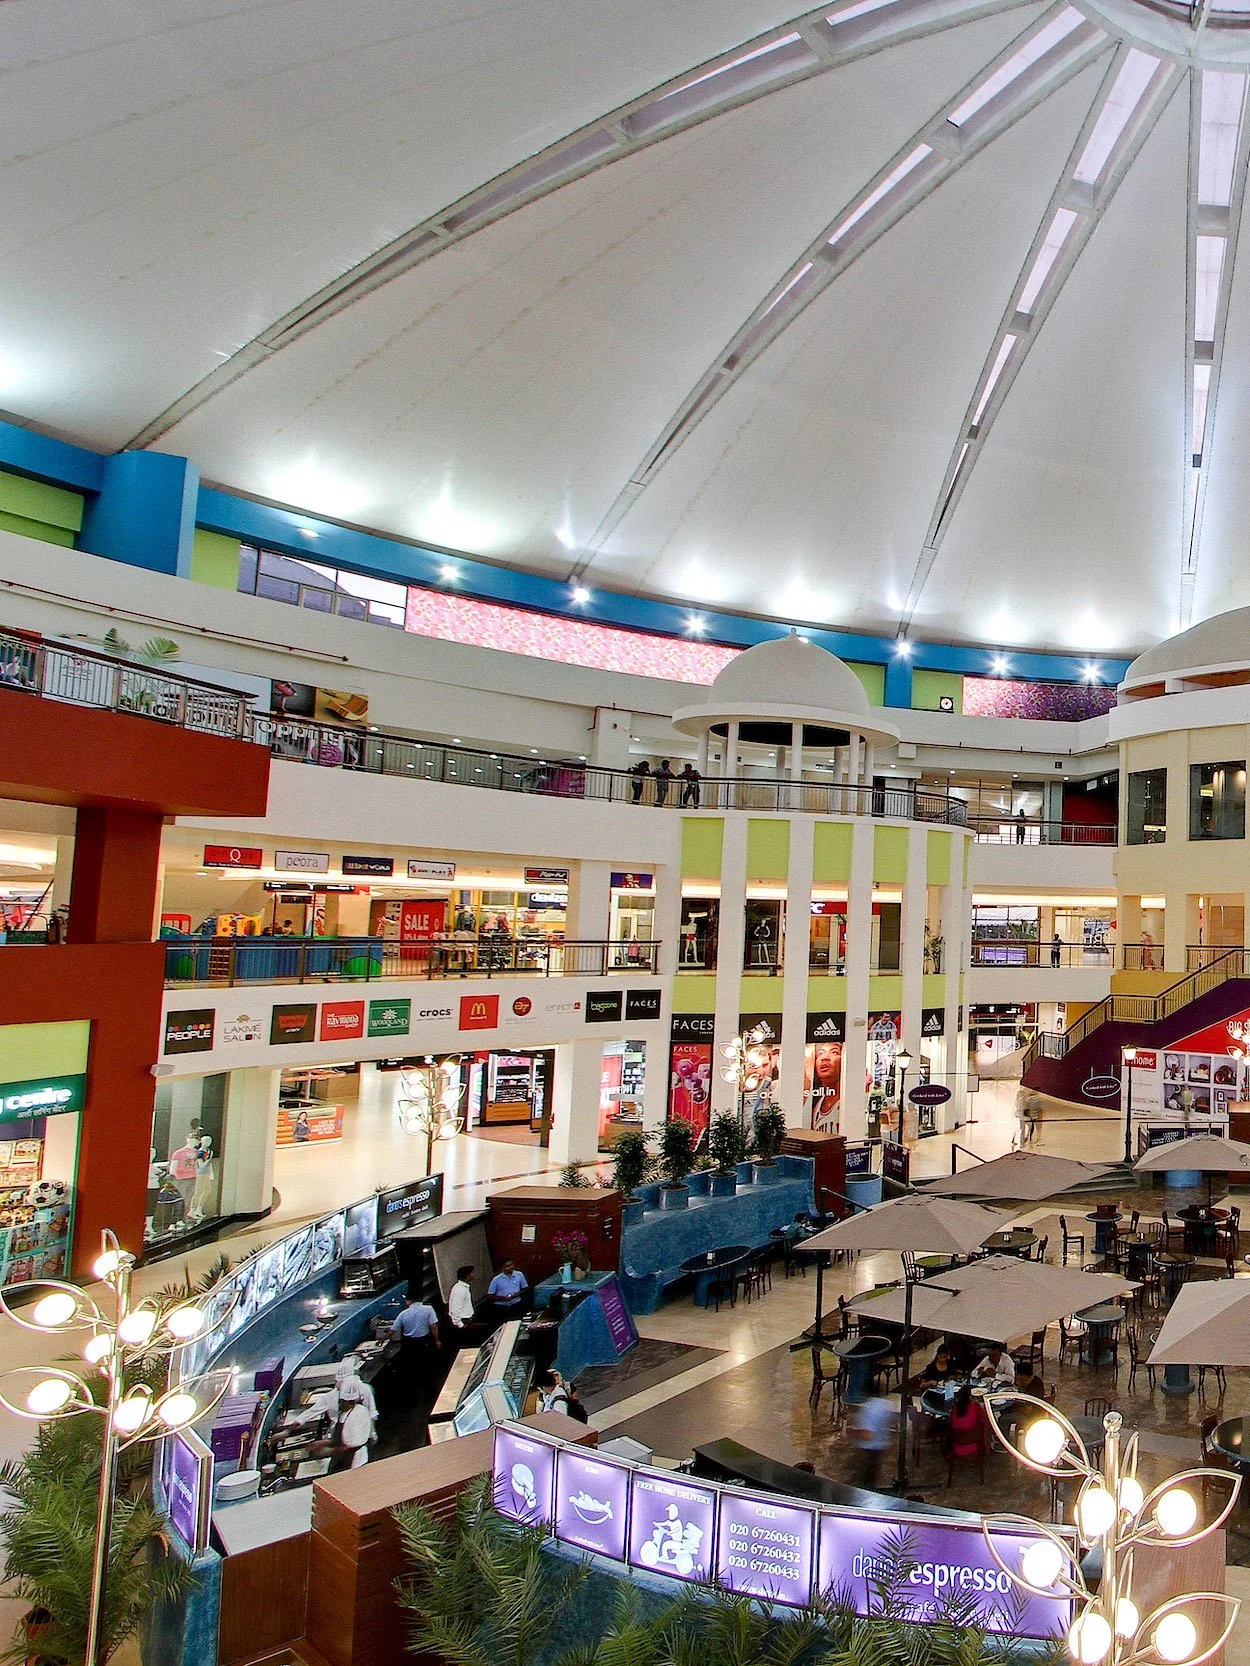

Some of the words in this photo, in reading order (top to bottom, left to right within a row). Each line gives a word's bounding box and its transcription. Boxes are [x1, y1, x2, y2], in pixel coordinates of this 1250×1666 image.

[404, 914, 429, 930] SALE
[420, 1008, 451, 1017] crocs
[672, 1020, 714, 1030] FACES
[924, 1023, 941, 1032] adidas
[167, 1030, 211, 1042] PEOPLE
[814, 1027, 840, 1036] adidas
[812, 1087, 825, 1097] all
[826, 1086, 836, 1096] in
[636, 1480, 653, 1491] FREE
[654, 1484, 677, 1496] HOME
[677, 1489, 712, 1504] DELIVERY
[755, 1508, 777, 1519] CALL
[730, 1523, 749, 1536] 020
[751, 1526, 801, 1546] 67260431
[729, 1539, 748, 1552] 020
[750, 1542, 801, 1563] 67260432
[728, 1555, 748, 1568] 020
[750, 1558, 800, 1581] 67260433
[909, 1560, 1012, 1598] espresso
